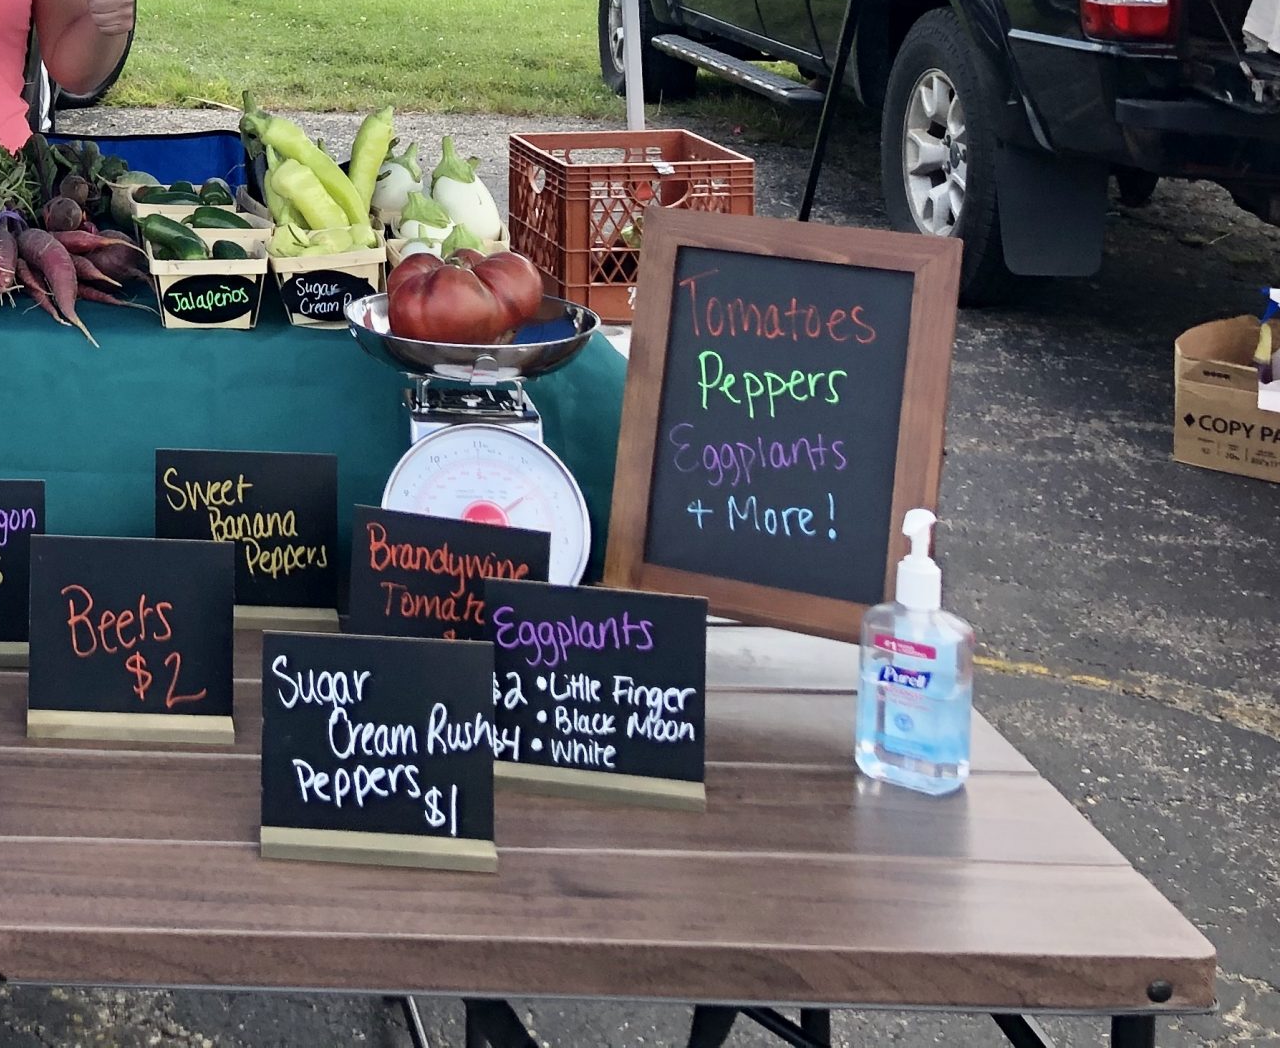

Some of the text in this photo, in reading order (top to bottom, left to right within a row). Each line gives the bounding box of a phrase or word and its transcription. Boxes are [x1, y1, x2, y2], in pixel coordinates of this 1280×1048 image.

[168, 285, 249, 312] Jalapeños
[295, 278, 339, 300] Sugar
[300, 297, 339, 314] Cream
[679, 268, 877, 344] Tomatoes
[697, 350, 848, 419] Peppers
[1199, 415, 1255, 439] COPY
[669, 423, 847, 487] Eggplants
[163, 467, 254, 511] Sweet
[208, 506, 298, 542] Banana
[727, 492, 837, 541] More!
[242, 537, 328, 579] Peppers
[366, 523, 529, 595] Brandywine
[60, 584, 174, 658] Beets
[493, 606, 654, 667] Eggplants
[125, 651, 207, 708] $2
[272, 654, 371, 709] Sugar
[550, 672, 601, 702] Little
[612, 675, 697, 720] Finger
[328, 703, 493, 760] Cream Rush
[555, 706, 696, 742] Black Moon
[551, 739, 616, 768] White
[292, 759, 422, 808] Peppers
[424, 784, 458, 837] $1
